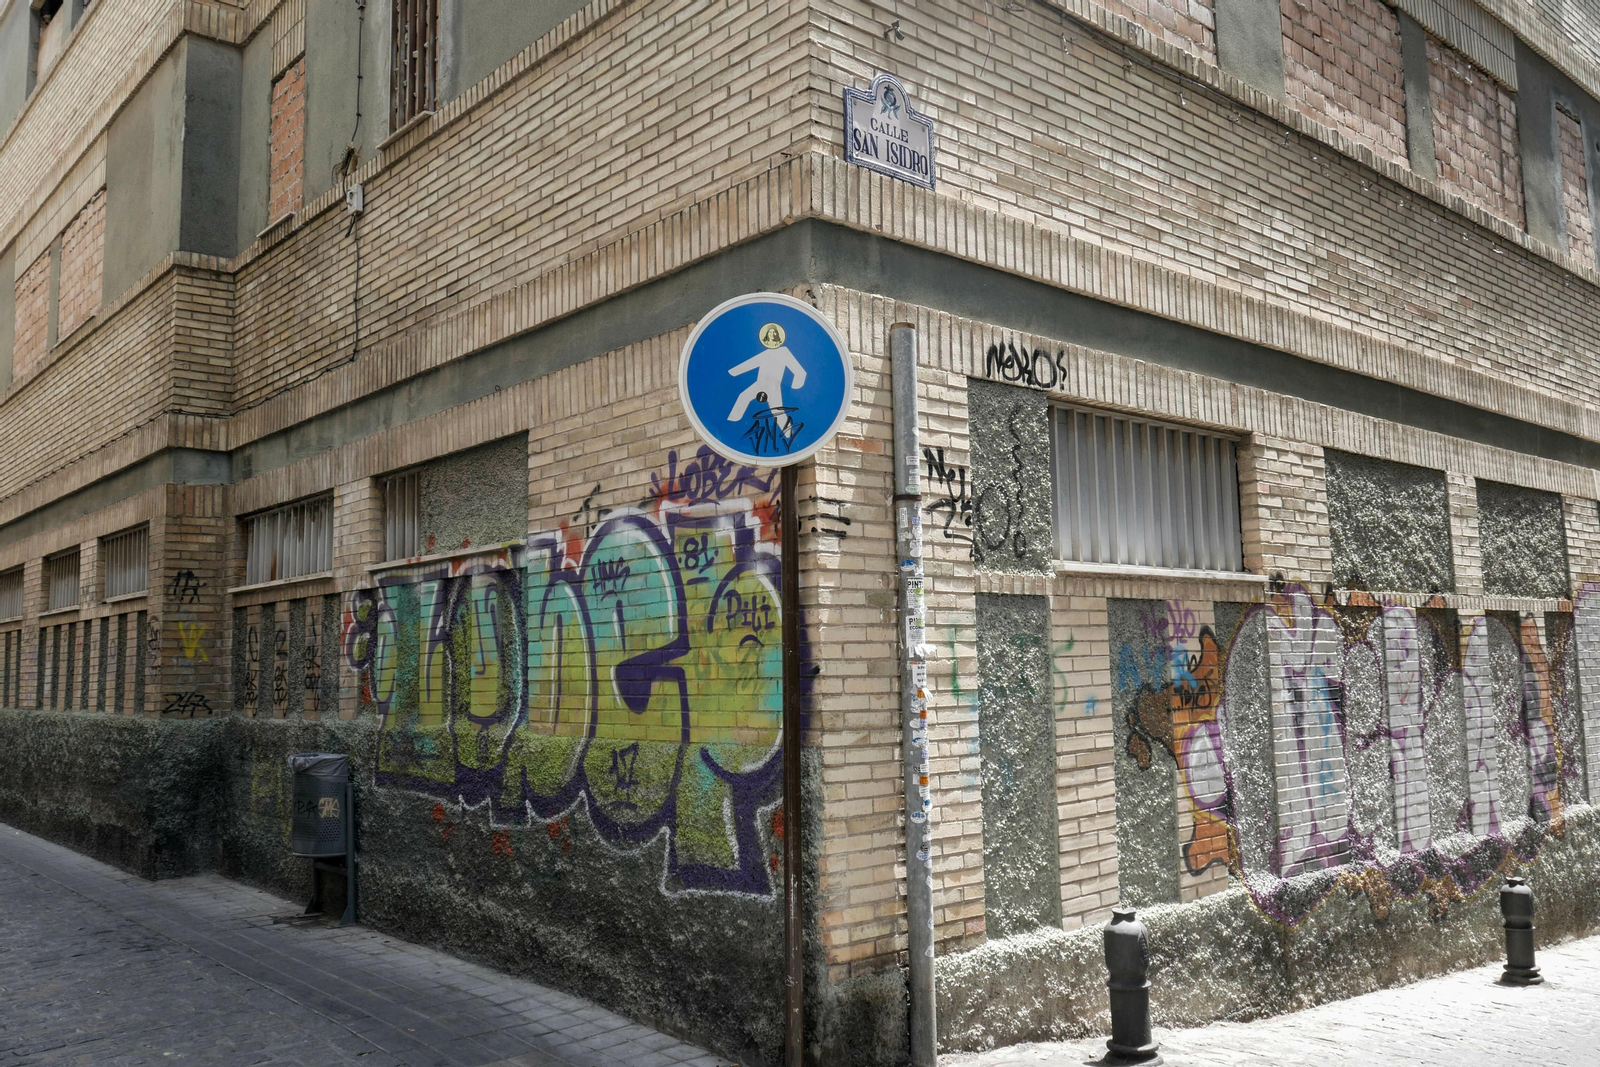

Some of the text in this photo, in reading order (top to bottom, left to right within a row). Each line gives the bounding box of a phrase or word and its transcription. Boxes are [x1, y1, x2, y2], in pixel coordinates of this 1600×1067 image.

[870, 117, 909, 144] CALLE
[853, 127, 929, 177] SAN ISIDRO
